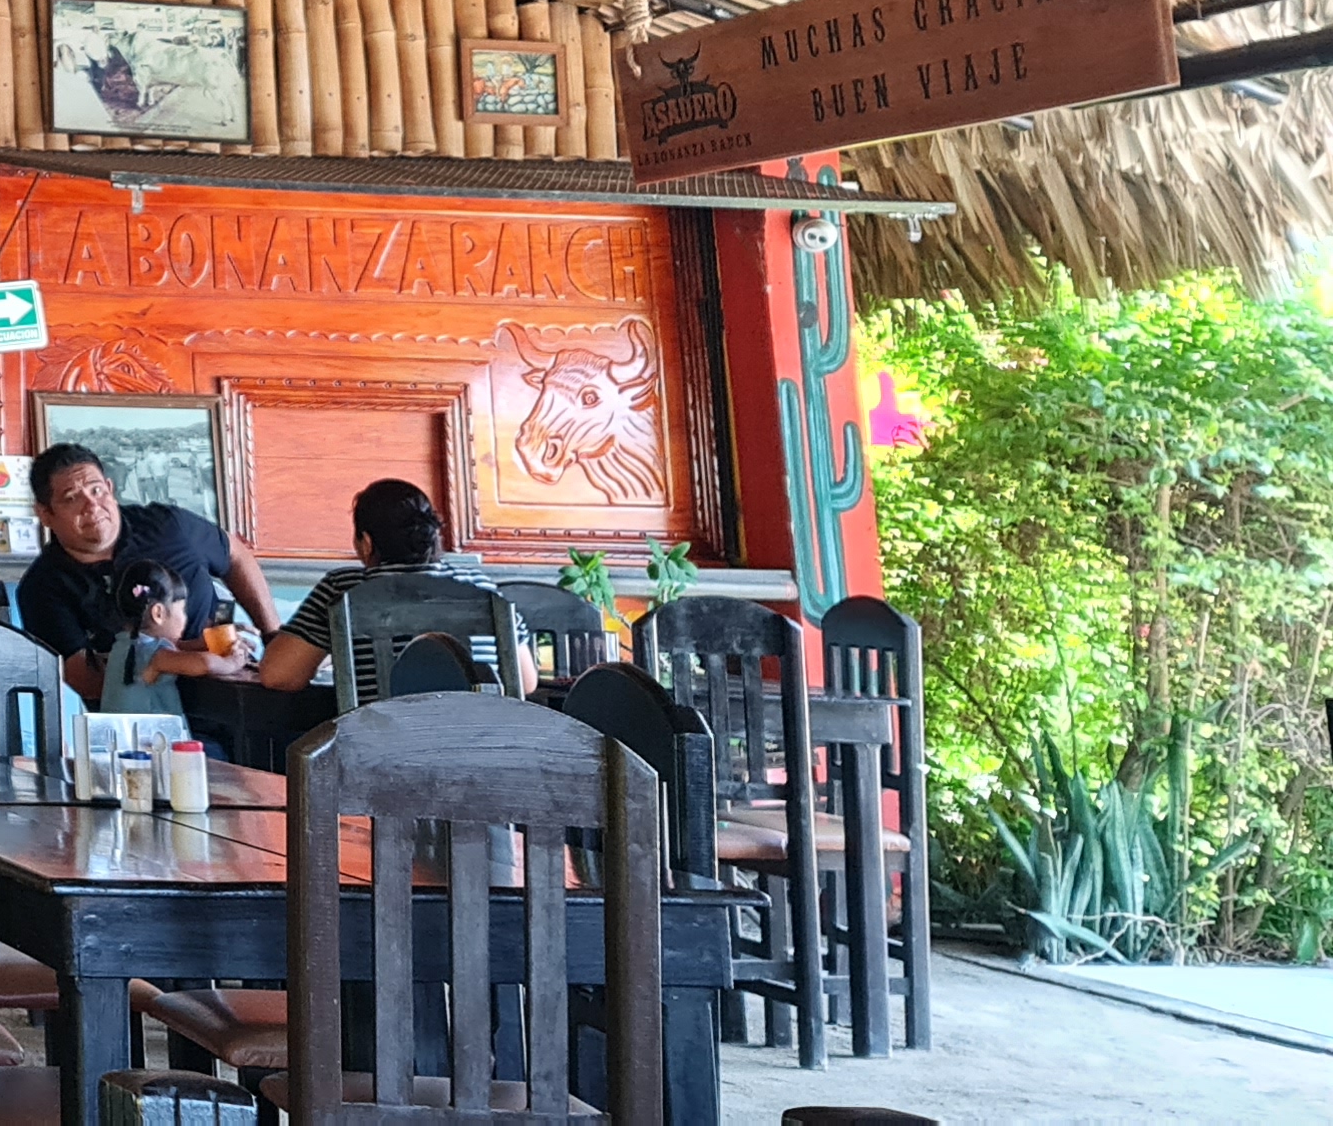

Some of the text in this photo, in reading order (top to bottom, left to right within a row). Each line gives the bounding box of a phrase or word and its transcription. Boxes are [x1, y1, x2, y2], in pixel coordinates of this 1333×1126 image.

[760, 6, 886, 70] MUCHAS
[641, 81, 737, 142] ASADERO
[810, 42, 1028, 123] BUEN VIAJE
[25, 209, 645, 302] LA BONANZA RANCH
[16, 529, 31, 539] 14
